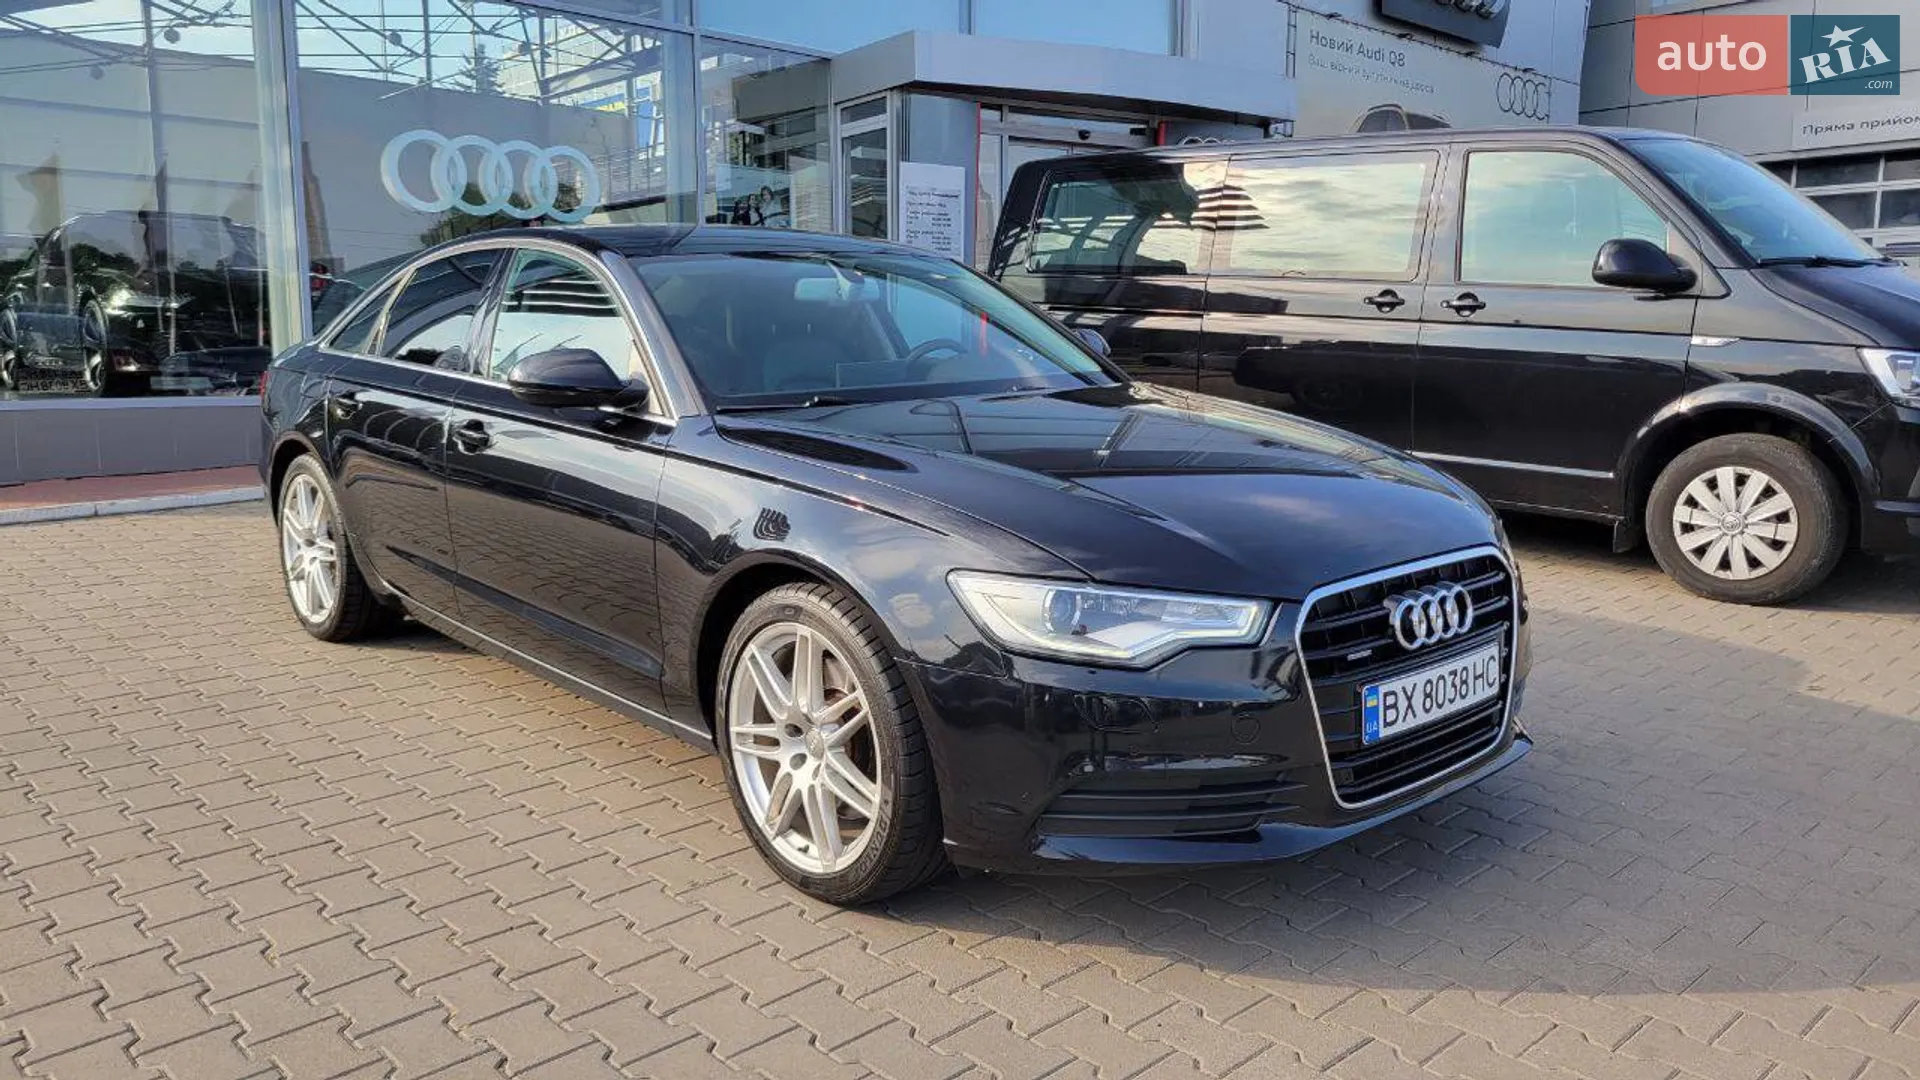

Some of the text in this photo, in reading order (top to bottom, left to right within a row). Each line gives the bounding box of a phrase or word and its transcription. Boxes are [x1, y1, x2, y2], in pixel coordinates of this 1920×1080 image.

[1309, 29, 1405, 67] Новий Audi Q8
[1802, 122, 1855, 136] Пряма
[1383, 656, 1497, 728] BX 8038 HC
[1366, 721, 1378, 733] UA
